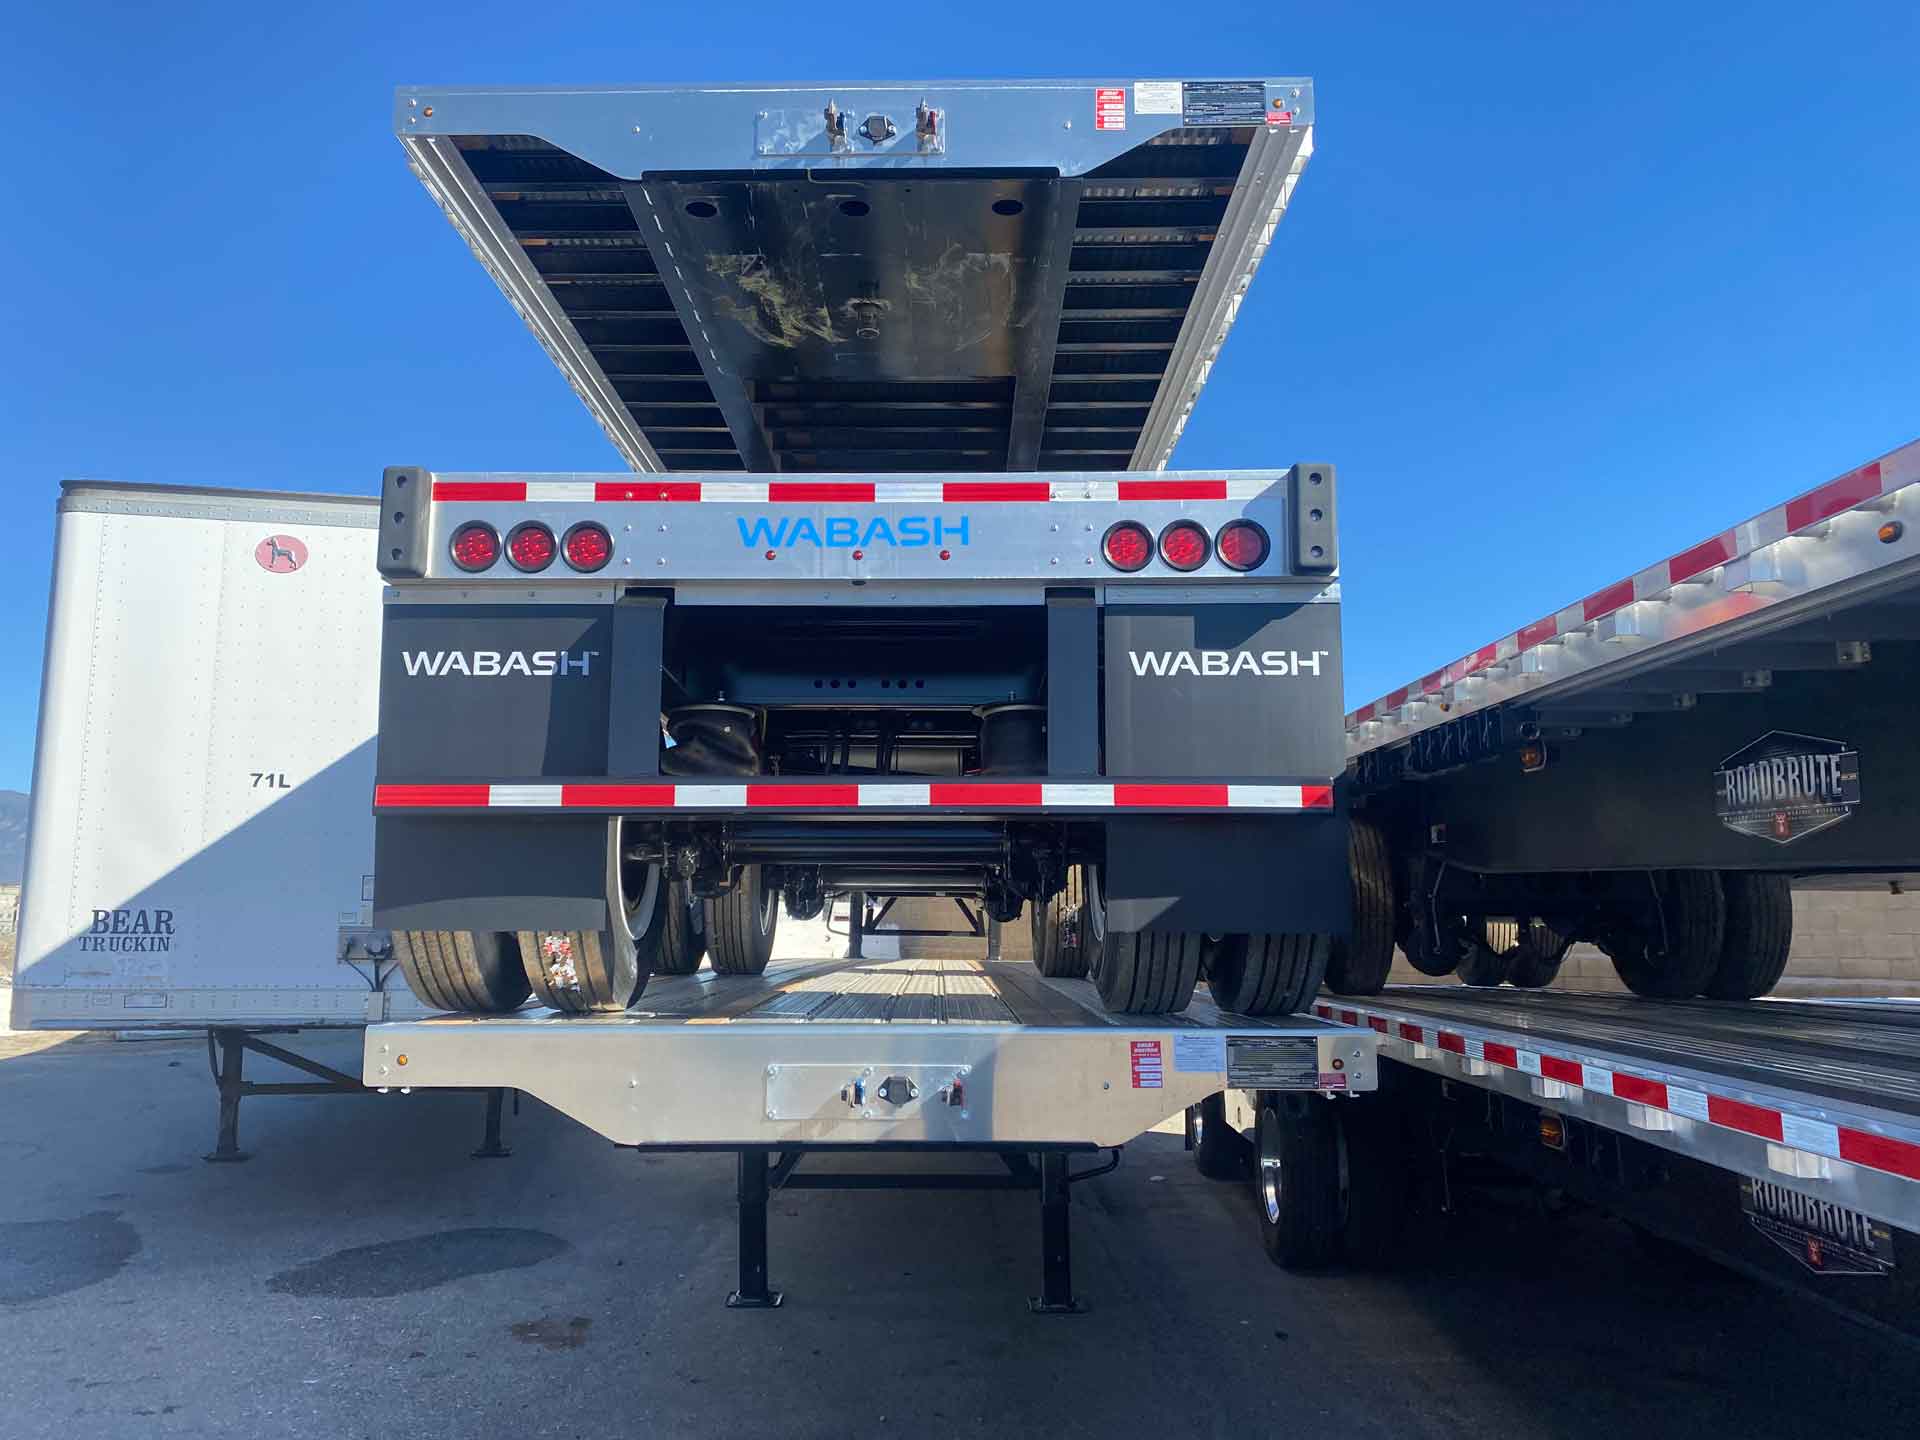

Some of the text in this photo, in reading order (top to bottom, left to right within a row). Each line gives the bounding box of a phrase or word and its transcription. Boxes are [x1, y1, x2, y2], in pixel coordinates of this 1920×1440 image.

[736, 516, 970, 547] WABASH
[401, 651, 590, 676] WABASH
[1128, 651, 1321, 676] WABASH
[249, 773, 291, 788] 71L
[1726, 754, 1842, 806] ROADBRUTE
[89, 909, 176, 935] BEAR
[79, 936, 170, 952] TRUCKIN
